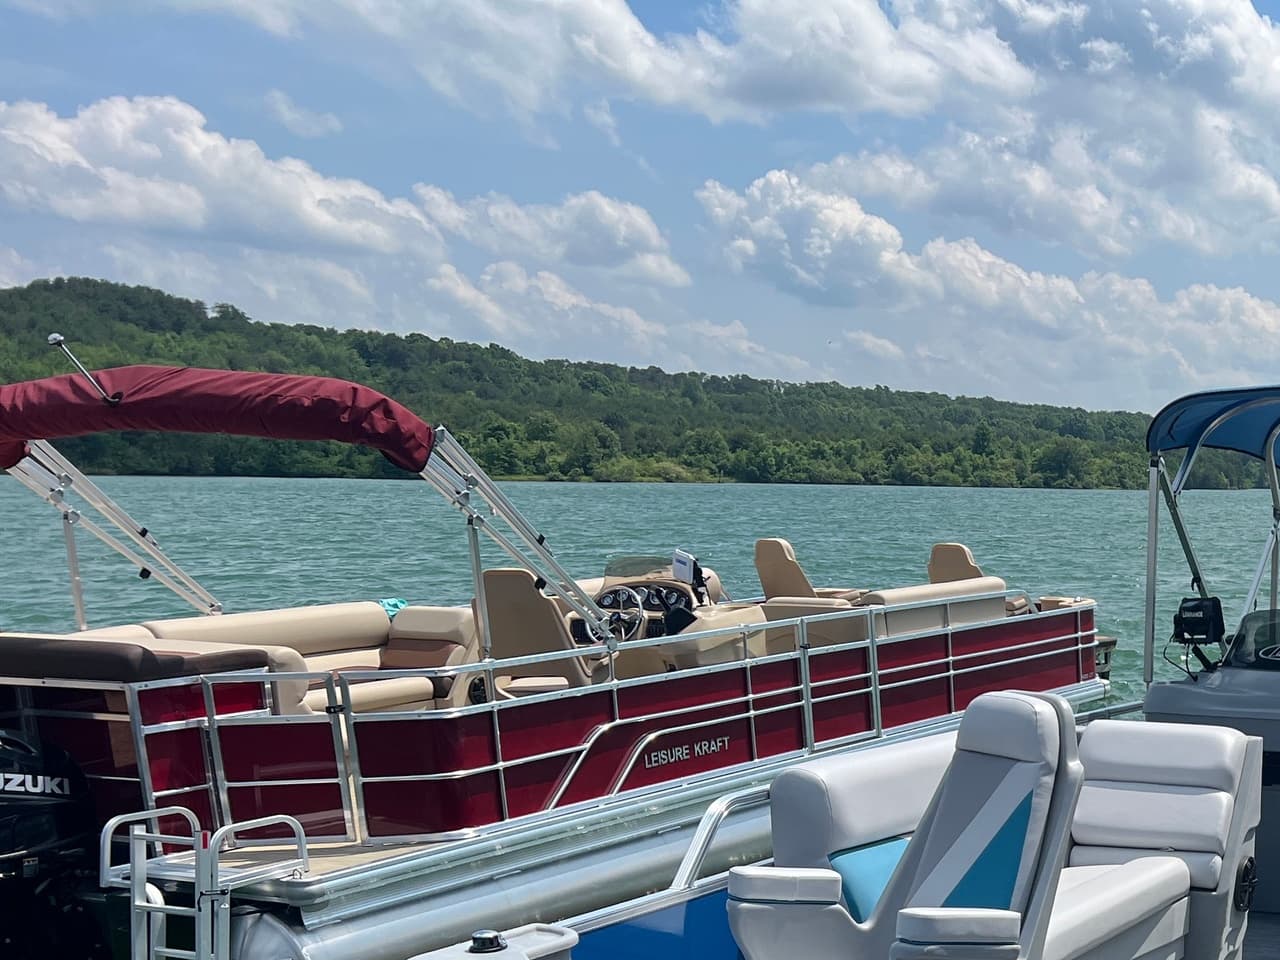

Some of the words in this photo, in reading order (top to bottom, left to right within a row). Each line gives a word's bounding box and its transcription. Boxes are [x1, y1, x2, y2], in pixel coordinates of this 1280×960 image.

[644, 745, 690, 769] LEISURE
[694, 736, 730, 757] KRAFT
[0, 773, 70, 795] ZUKI
